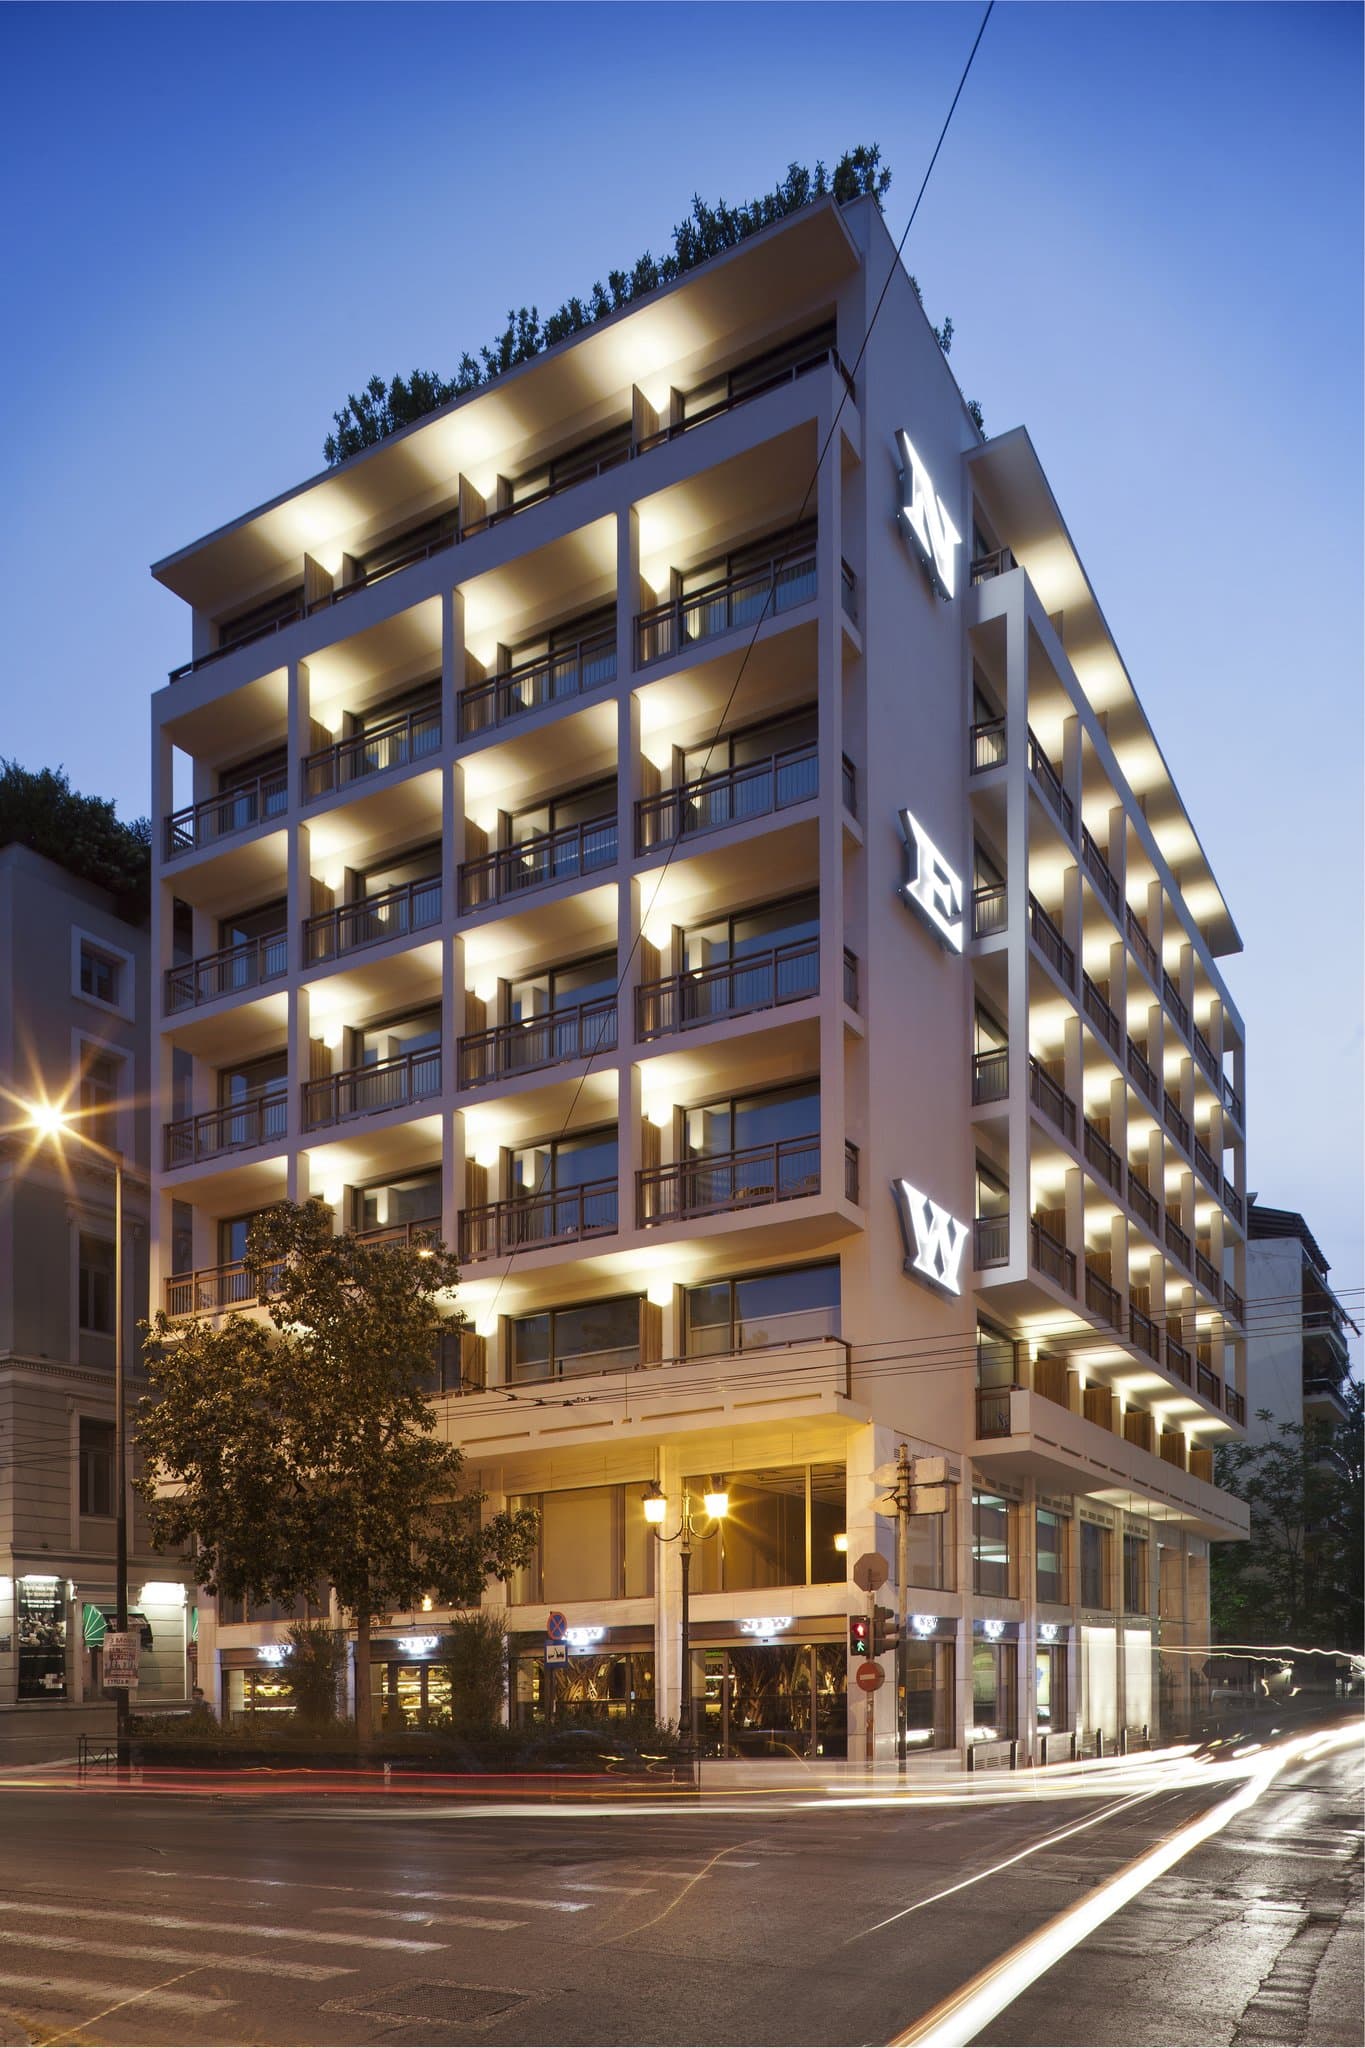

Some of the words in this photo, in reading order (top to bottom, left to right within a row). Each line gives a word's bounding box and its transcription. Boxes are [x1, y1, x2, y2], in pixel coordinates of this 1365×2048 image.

[899, 430, 970, 1297] NEW
[739, 1617, 790, 1630] NEW
[398, 1637, 436, 1650] NEW
